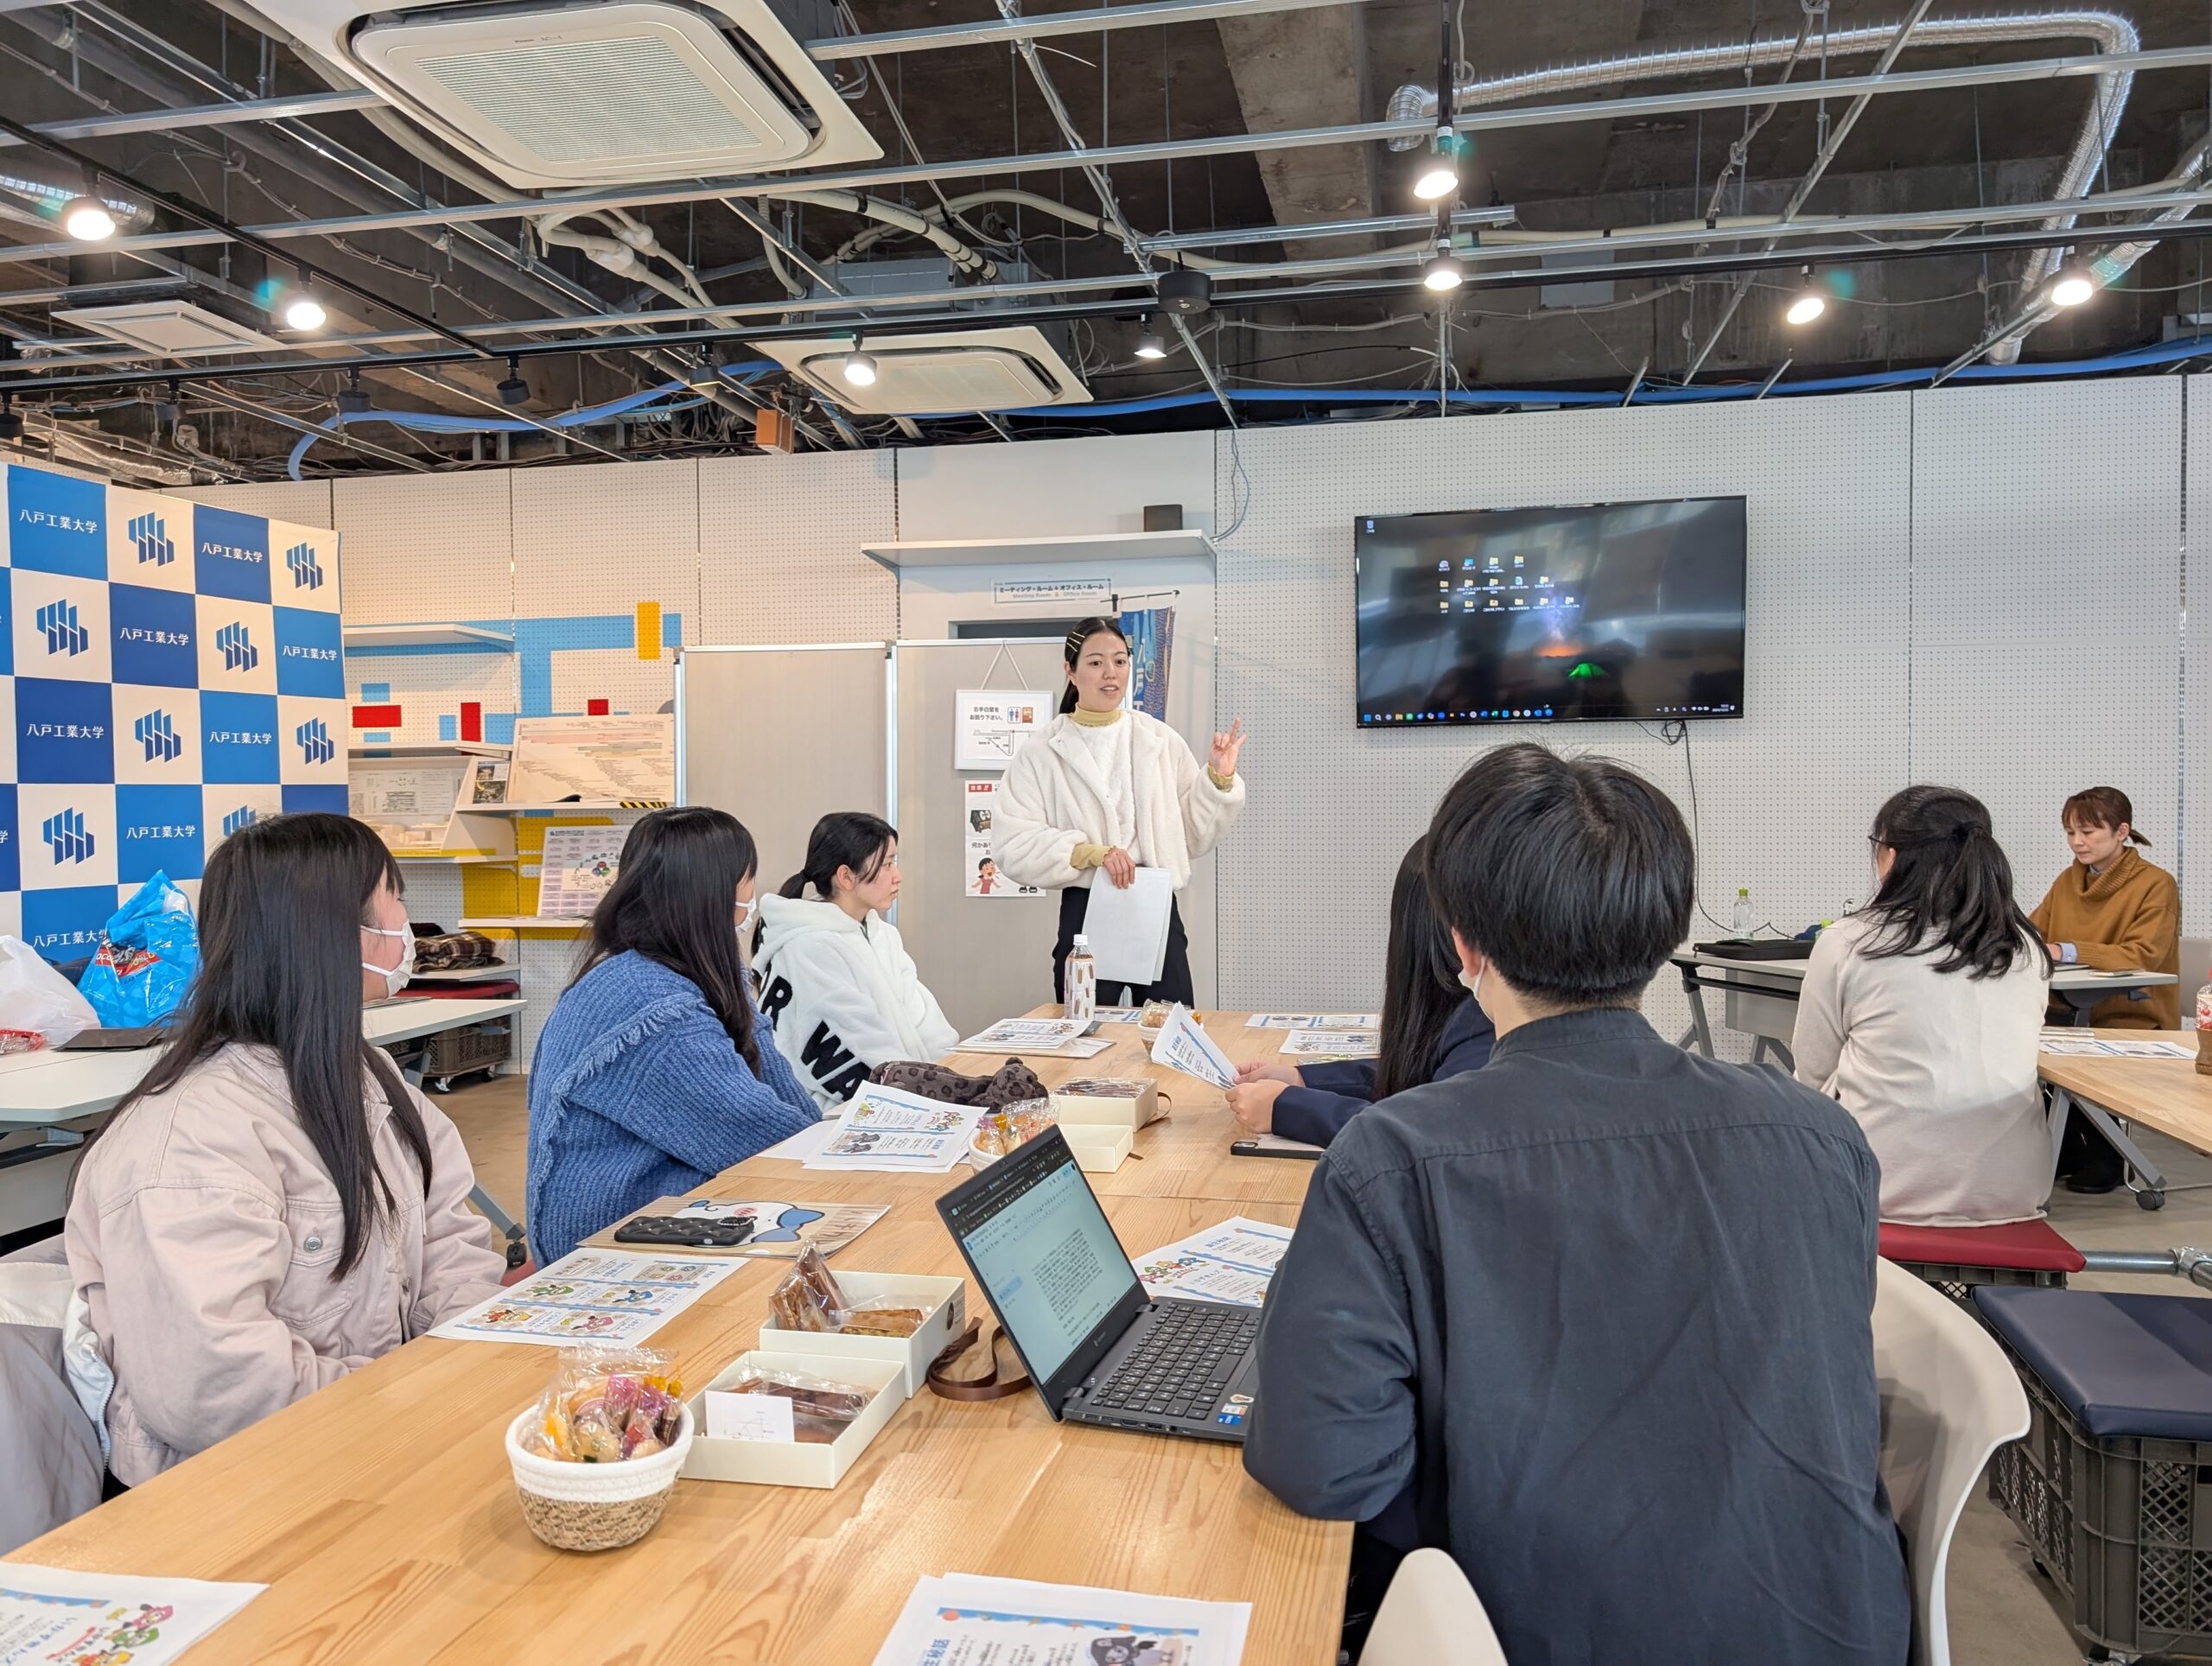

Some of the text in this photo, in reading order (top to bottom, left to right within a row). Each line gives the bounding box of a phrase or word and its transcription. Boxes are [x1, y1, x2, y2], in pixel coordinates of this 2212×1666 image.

[19, 509, 98, 534] 八戸工業大学
[201, 542, 264, 563] 八戸工業大学
[119, 627, 189, 646] 八戸工業大学
[283, 645, 337, 661] 八戸工業大学
[26, 723, 105, 740] 八戸工業大学
[209, 731, 272, 745] 八戸工業大学
[126, 824, 196, 839] 八戸工業大学
